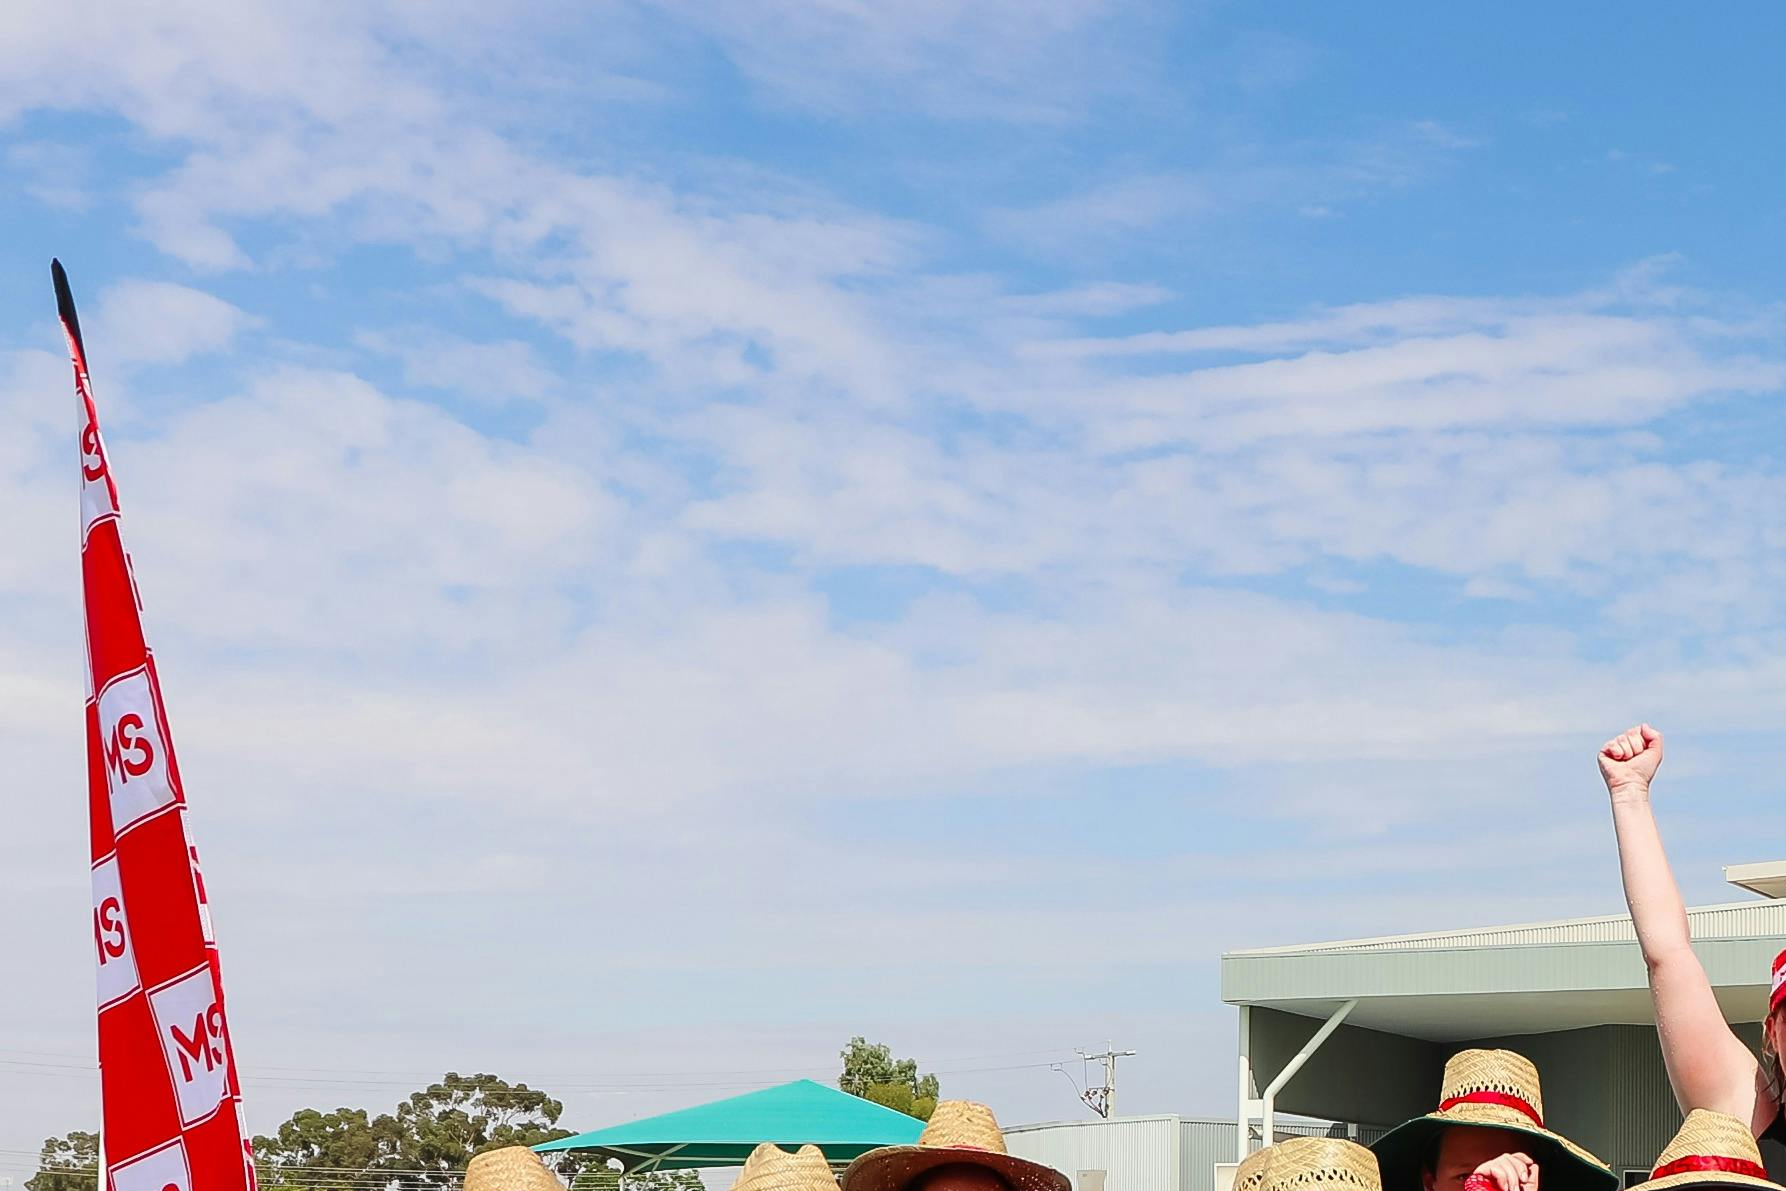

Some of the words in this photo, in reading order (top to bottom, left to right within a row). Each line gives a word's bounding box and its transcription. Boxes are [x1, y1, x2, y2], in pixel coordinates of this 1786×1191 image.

[82, 421, 109, 485] S
[103, 713, 155, 795] MS
[170, 1001, 225, 1084] MS
